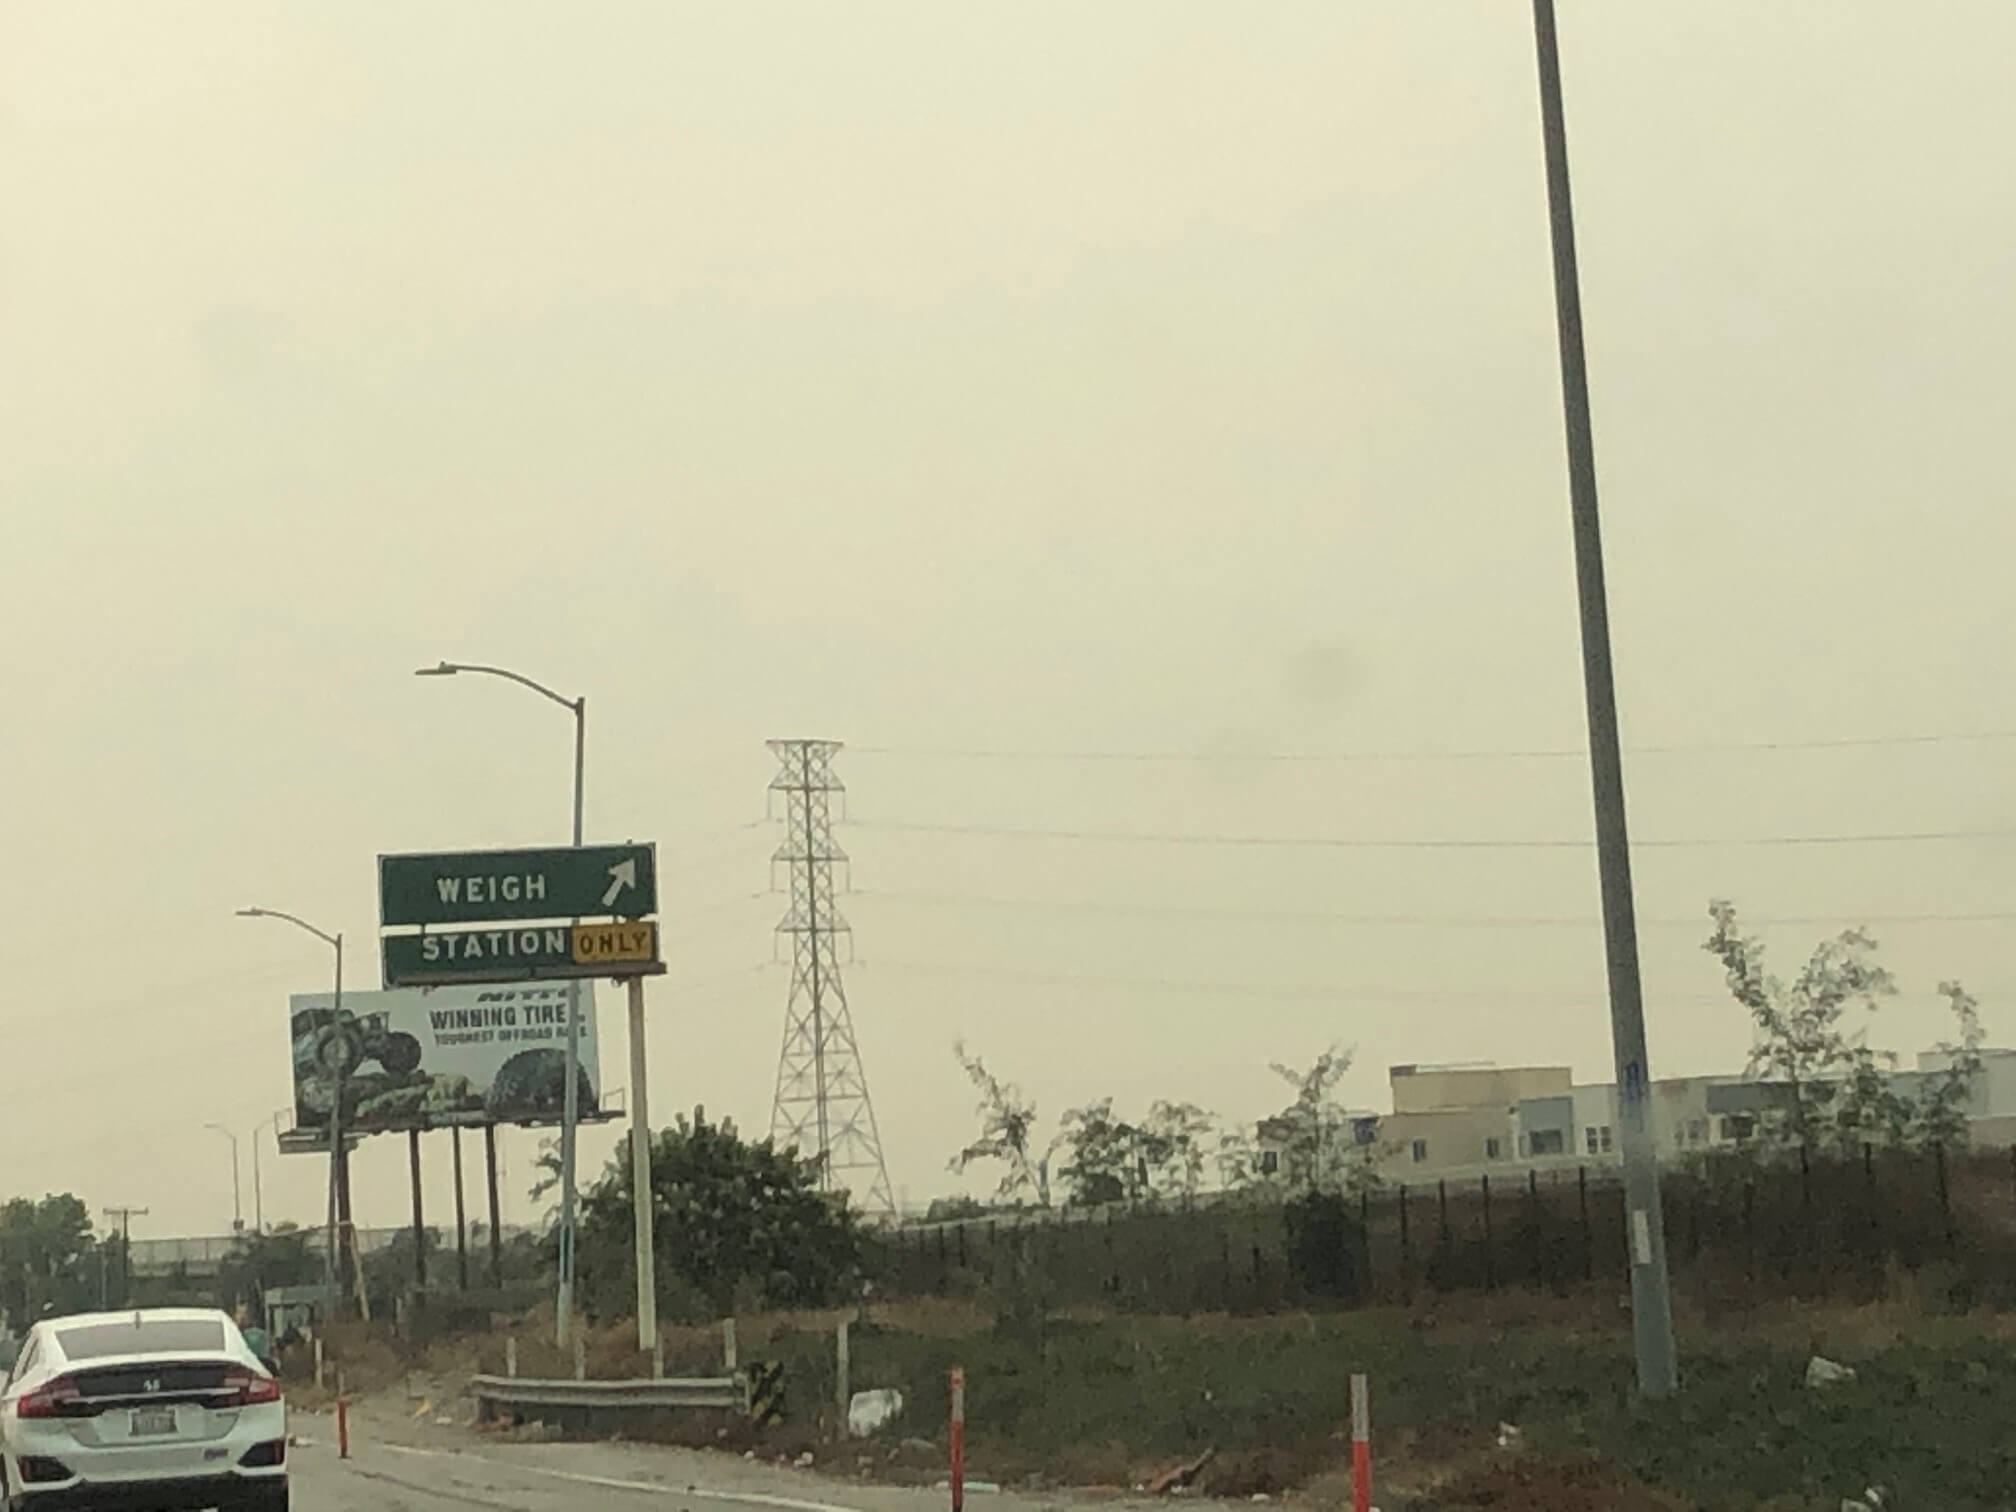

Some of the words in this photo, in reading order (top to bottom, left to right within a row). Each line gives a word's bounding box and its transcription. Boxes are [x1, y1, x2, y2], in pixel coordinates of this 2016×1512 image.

[437, 874, 546, 904] WEIGH
[422, 929, 565, 961] STATION
[579, 931, 648, 955] ONLY
[430, 1007, 516, 1029] WINNING
